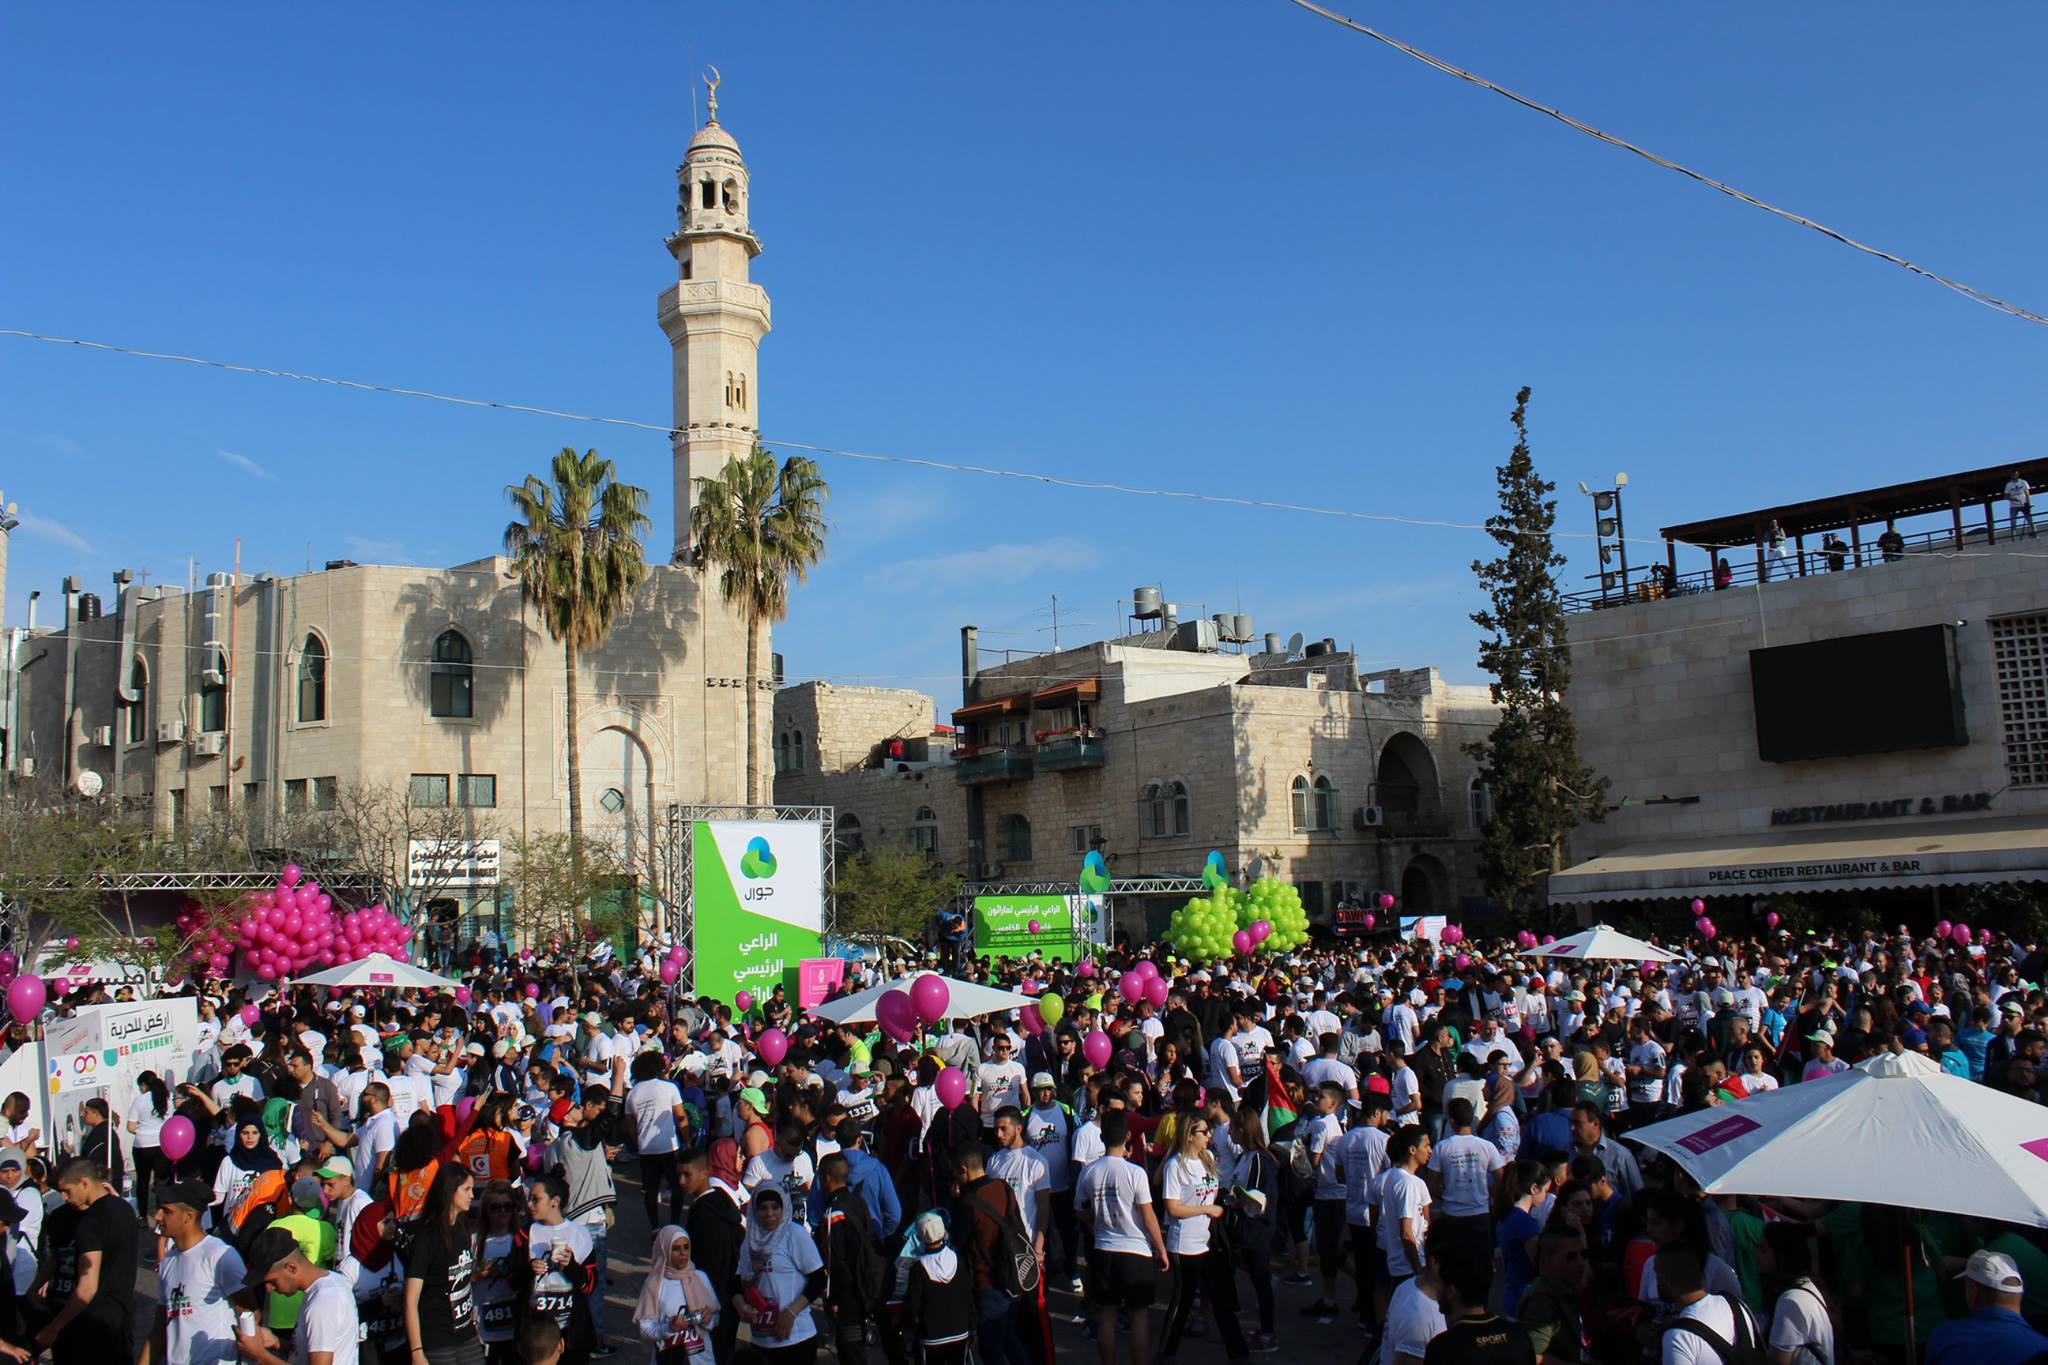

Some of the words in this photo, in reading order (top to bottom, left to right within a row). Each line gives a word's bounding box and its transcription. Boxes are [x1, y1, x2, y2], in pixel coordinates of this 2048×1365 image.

[1771, 798, 1914, 826] RESTAURANT
[1919, 797, 1937, 815] &
[1942, 791, 1992, 813] BAR
[1709, 869, 1745, 881] PEACE
[1749, 866, 1794, 879] CENTER
[1799, 861, 1877, 876] RESTAURANT
[1880, 861, 1890, 872] &
[1893, 859, 1920, 871] BAR
[744, 887, 774, 901] جوال
[739, 932, 778, 956] الراعي
[733, 958, 783, 983] الرئيسي
[111, 1017, 142, 1040] للحرية
[144, 1011, 170, 1032] اركض
[131, 1035, 174, 1054] MOVEMENT
[848, 1104, 872, 1118] 1333
[536, 1295, 573, 1311] 3714
[485, 1306, 513, 1321] 481
[1476, 1333, 1507, 1345] SPORT
